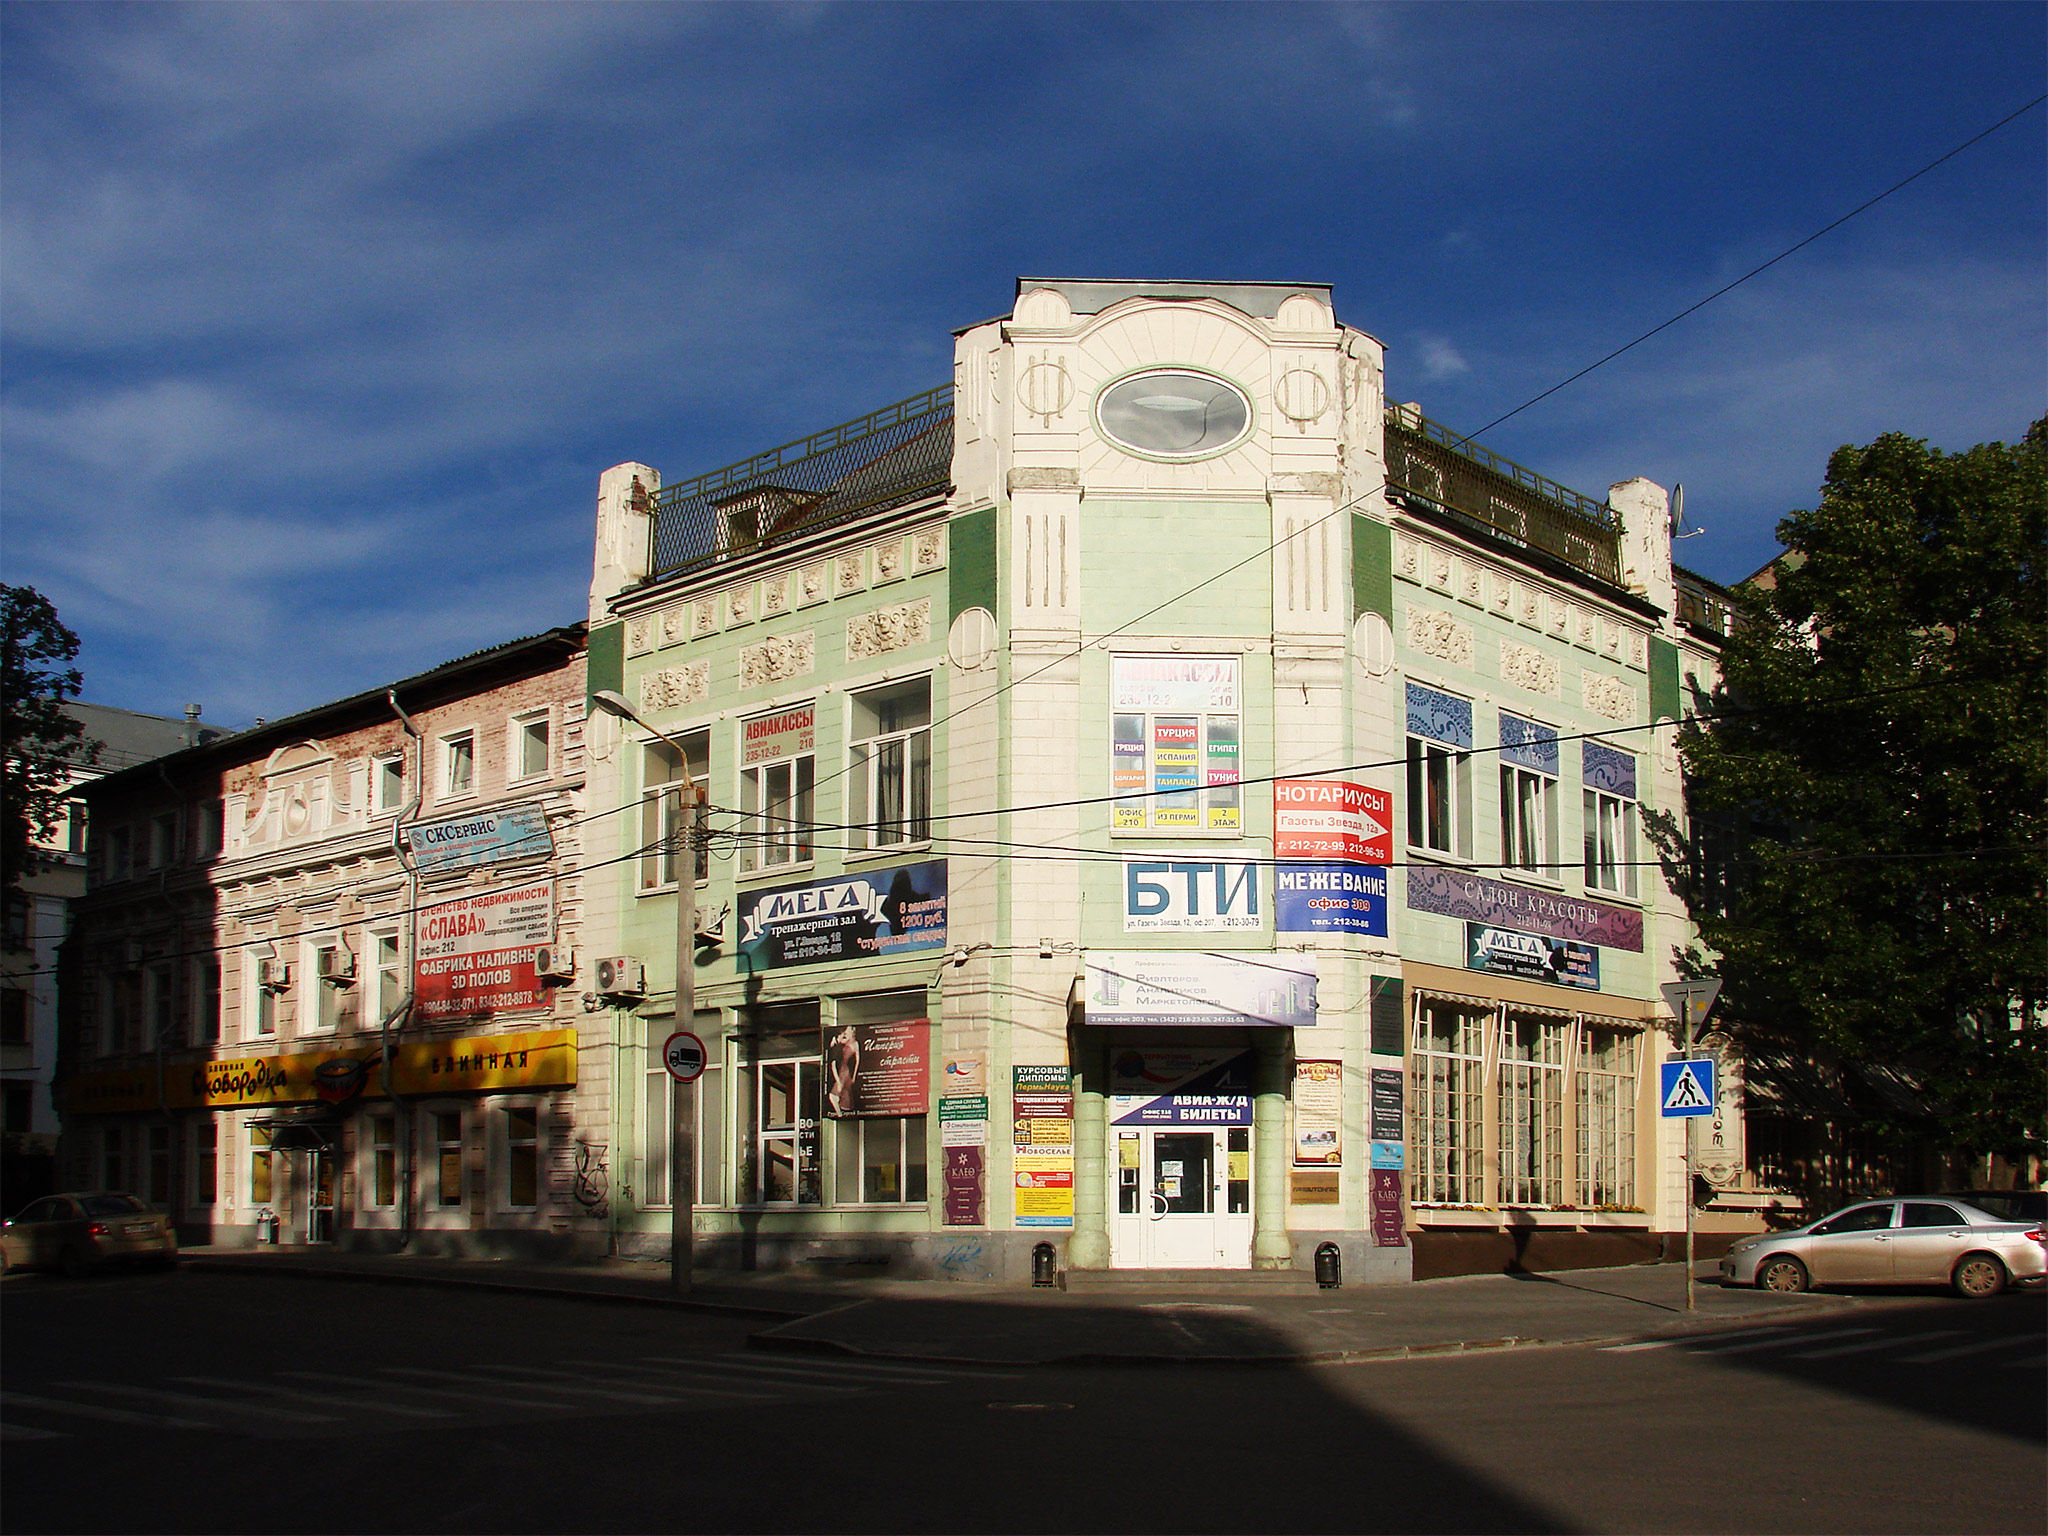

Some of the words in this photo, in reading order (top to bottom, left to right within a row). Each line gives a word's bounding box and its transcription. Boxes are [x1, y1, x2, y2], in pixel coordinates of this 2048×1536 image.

[746, 709, 814, 741] АВИАКАССЫ
[1157, 728, 1196, 738] ТУРЦИЯ
[745, 744, 781, 762] 235-12-22
[798, 737, 814, 750] 210
[1115, 744, 1145, 753] ГРЕЦИЯ
[1208, 744, 1238, 753] ЕГИПЕТ
[1208, 773, 1238, 782] ТУНИС
[1276, 786, 1384, 812] НОТАРИУСЫ
[1281, 816, 1324, 826] Газеты
[1327, 817, 1364, 832] Звезда,
[1366, 823, 1379, 834] 12а
[1277, 842, 1287, 850] т.
[1289, 840, 1348, 853] 212-72-99,
[1349, 843, 1384, 859] 212-96-35
[1127, 863, 1258, 915] БТИ
[1278, 872, 1386, 897] МЕЖЕВАНИЕ
[471, 886, 549, 909] недвижимости
[767, 884, 860, 919] МЕГА
[1308, 897, 1349, 911] офис
[1351, 898, 1371, 912] 309
[1464, 881, 1519, 908] САЛОН
[1527, 895, 1600, 925] КРАСОТЫ
[899, 901, 906, 914] 8
[420, 912, 486, 941] «СЛАВА»
[770, 918, 839, 936] тренажерный
[840, 915, 856, 925] зал
[900, 914, 923, 929] 1200
[924, 910, 945, 927] руб.
[1127, 919, 1137, 928] ул.
[1310, 918, 1331, 926] тел.
[420, 945, 440, 956] офис
[441, 941, 456, 953] 212
[1490, 931, 1540, 954] МЕГА
[420, 956, 474, 976] ФАБРИКА
[452, 975, 466, 989] 3D
[469, 969, 512, 987] ПОЛОВ
[864, 1039, 904, 1052] Империя
[431, 1051, 528, 1074] БЛИННАЯ
[879, 1053, 920, 1068] страсти
[1016, 1083, 1070, 1091] ПермьНаука
[1173, 1096, 1248, 1107] АВИА-Ж/Д
[1180, 1108, 1241, 1120] БИЛЕТЫ
[1378, 1190, 1397, 1199] КЛЕО
